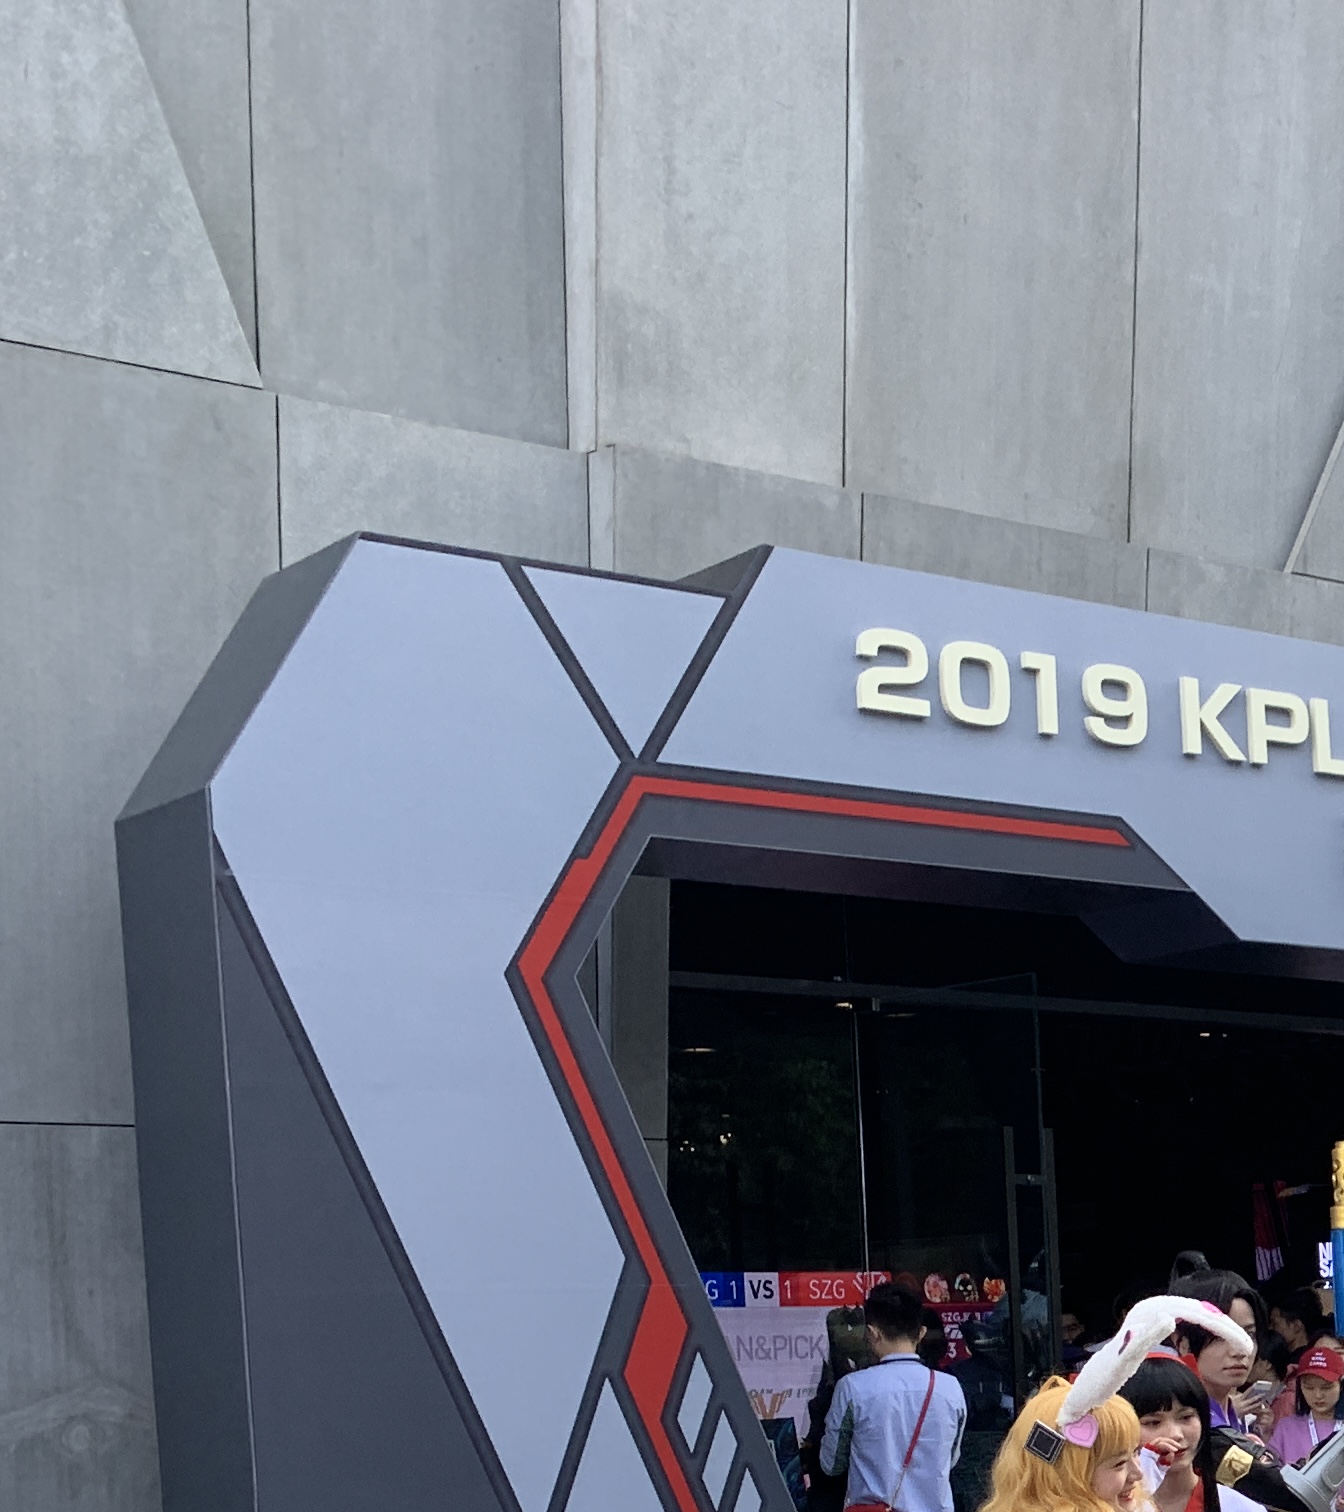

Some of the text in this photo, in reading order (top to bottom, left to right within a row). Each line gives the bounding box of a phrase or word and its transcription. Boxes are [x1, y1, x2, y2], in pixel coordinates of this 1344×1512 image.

[856, 627, 1148, 747] 2019
[729, 1280, 738, 1301] 1
[748, 1279, 774, 1300] VS
[784, 1281, 792, 1300] 1
[809, 1279, 846, 1300] SZG
[727, 1334, 826, 1362] N&PICK
